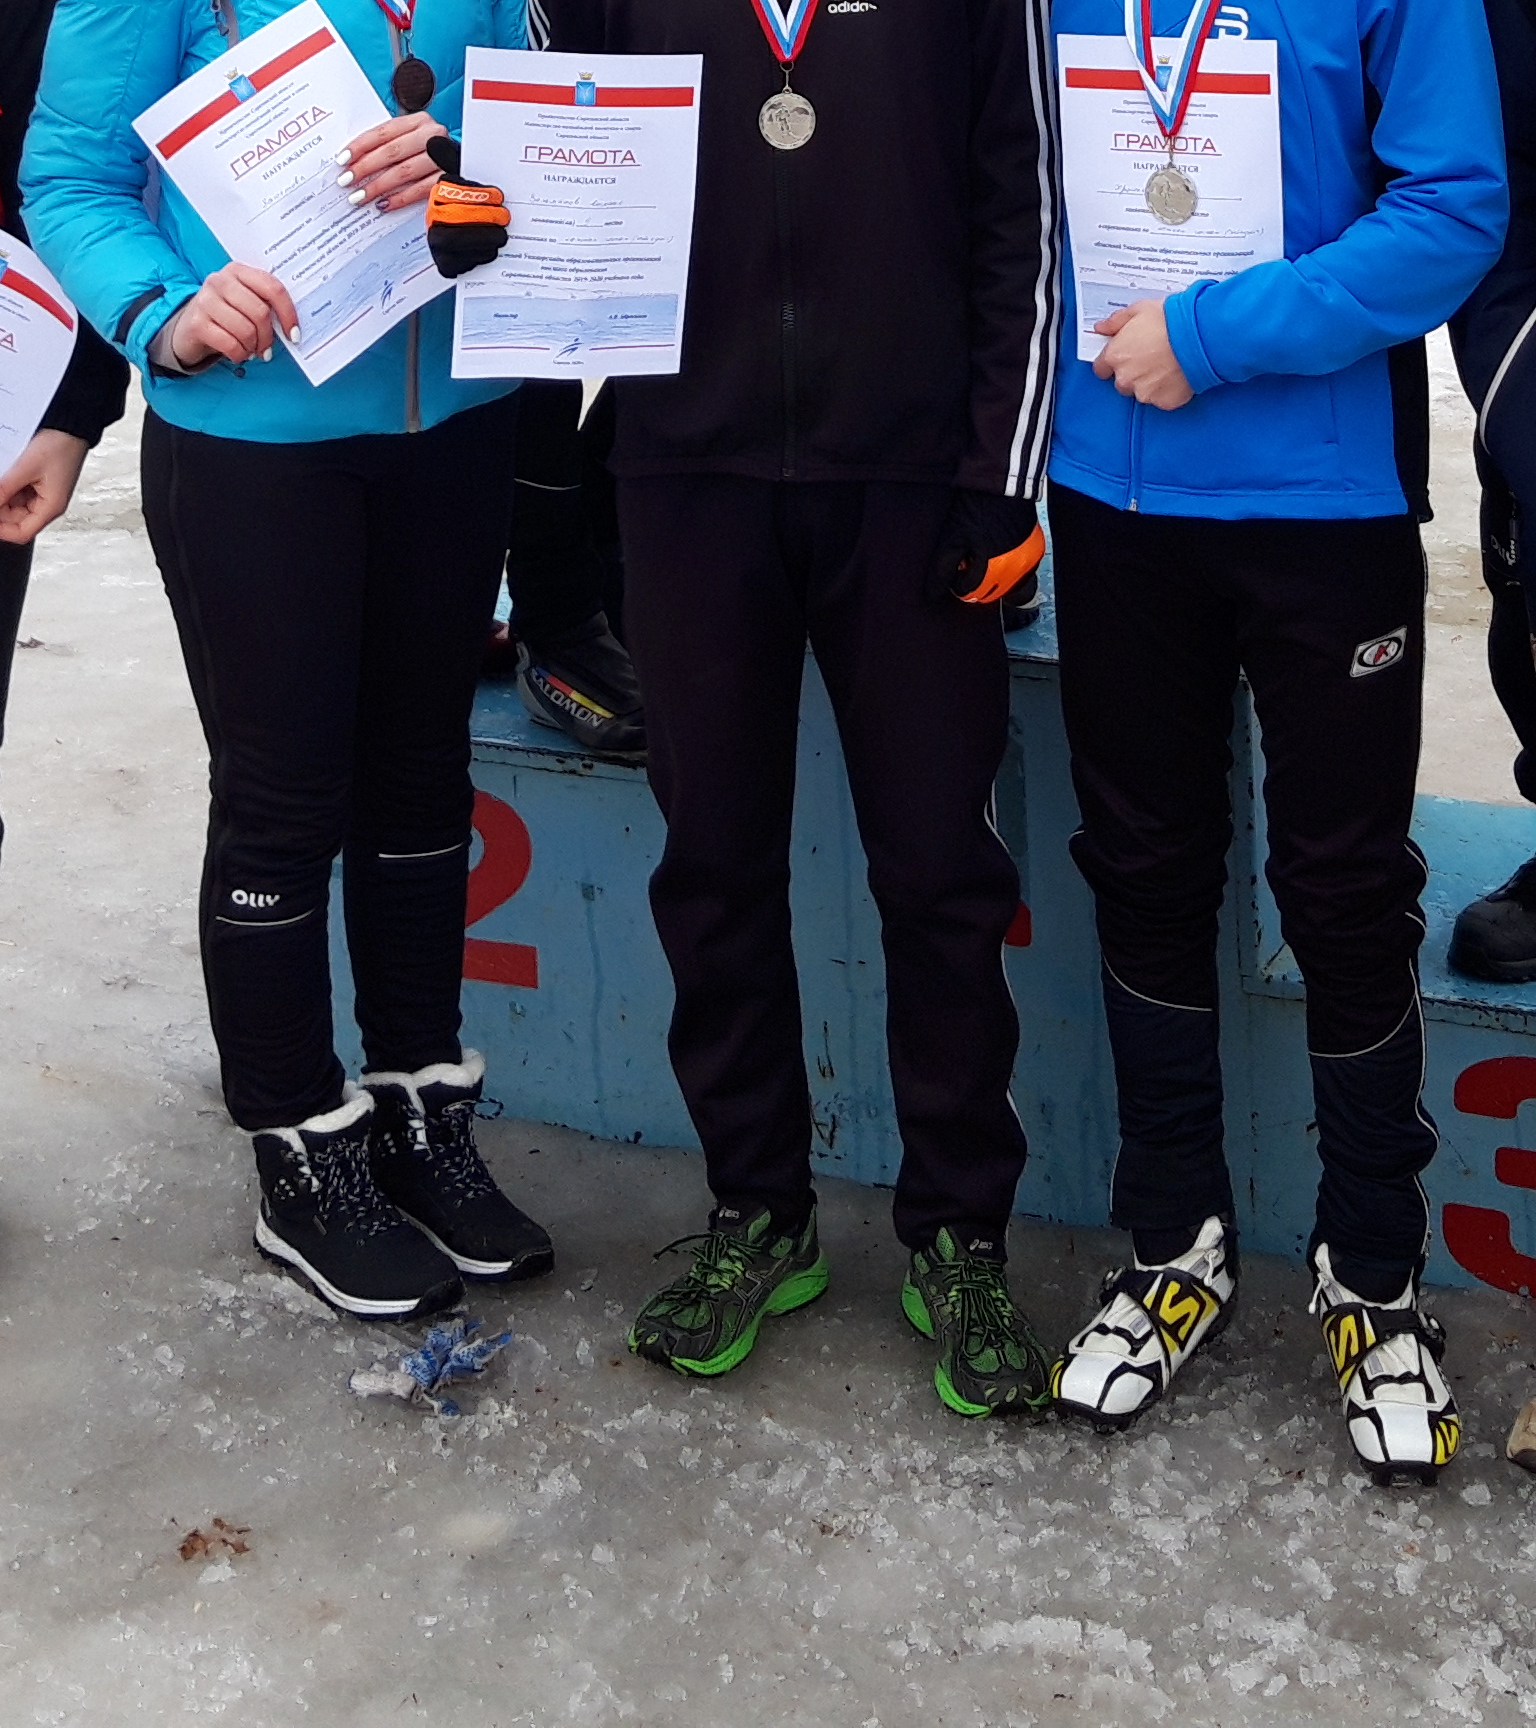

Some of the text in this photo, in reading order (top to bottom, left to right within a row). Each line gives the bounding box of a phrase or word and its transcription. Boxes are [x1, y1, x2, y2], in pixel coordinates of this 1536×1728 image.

[229, 105, 328, 178] ГРАМОТА
[261, 134, 324, 181] НАГРАЖДАЕТСЯ
[524, 145, 636, 165] ГРАМОТА
[1114, 133, 1217, 153] ГРАМОТА
[543, 174, 617, 185] НАГРАЖДАЕТСЯ
[530, 668, 605, 728] SALOMON
